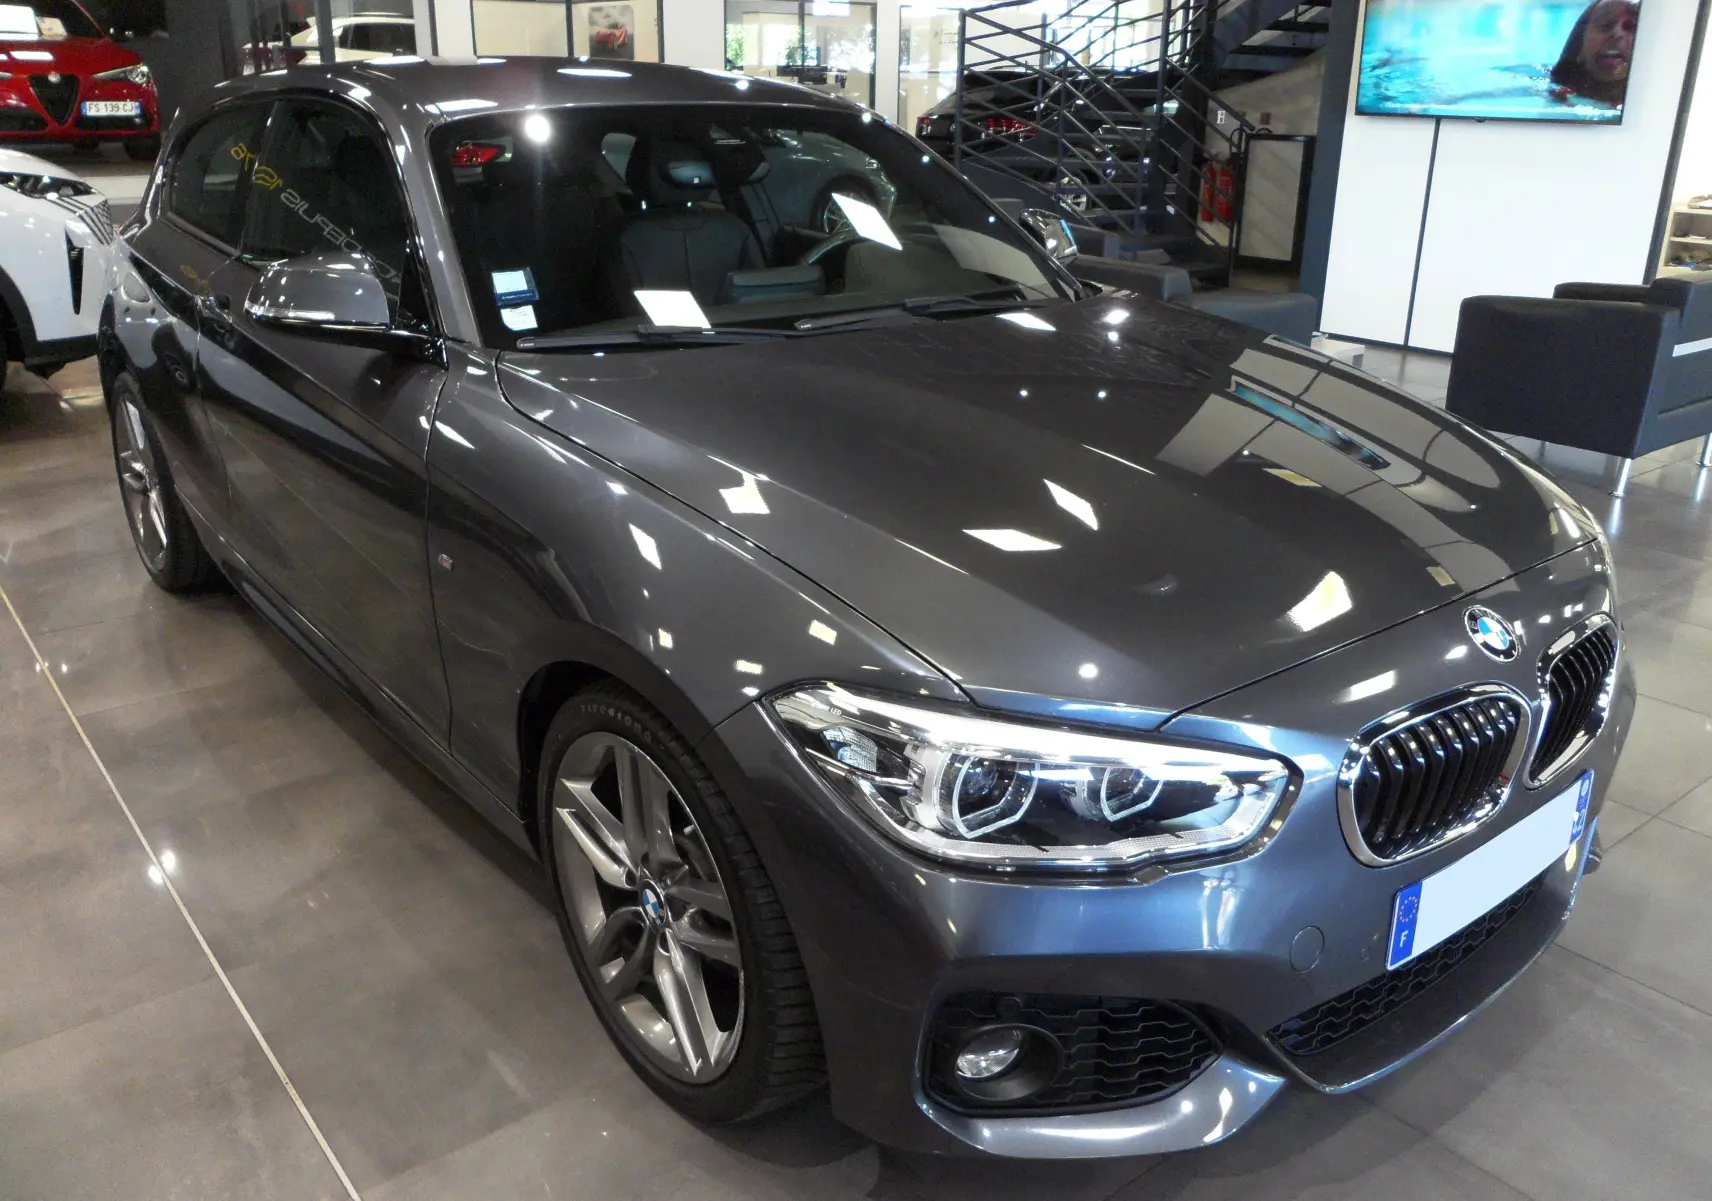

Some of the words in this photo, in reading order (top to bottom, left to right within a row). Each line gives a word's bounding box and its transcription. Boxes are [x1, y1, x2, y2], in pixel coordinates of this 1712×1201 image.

[88, 103, 100, 113] FS
[103, 103, 120, 113] 139
[122, 103, 134, 113] CJ
[830, 707, 842, 716] LED
[1399, 930, 1409, 948] F
